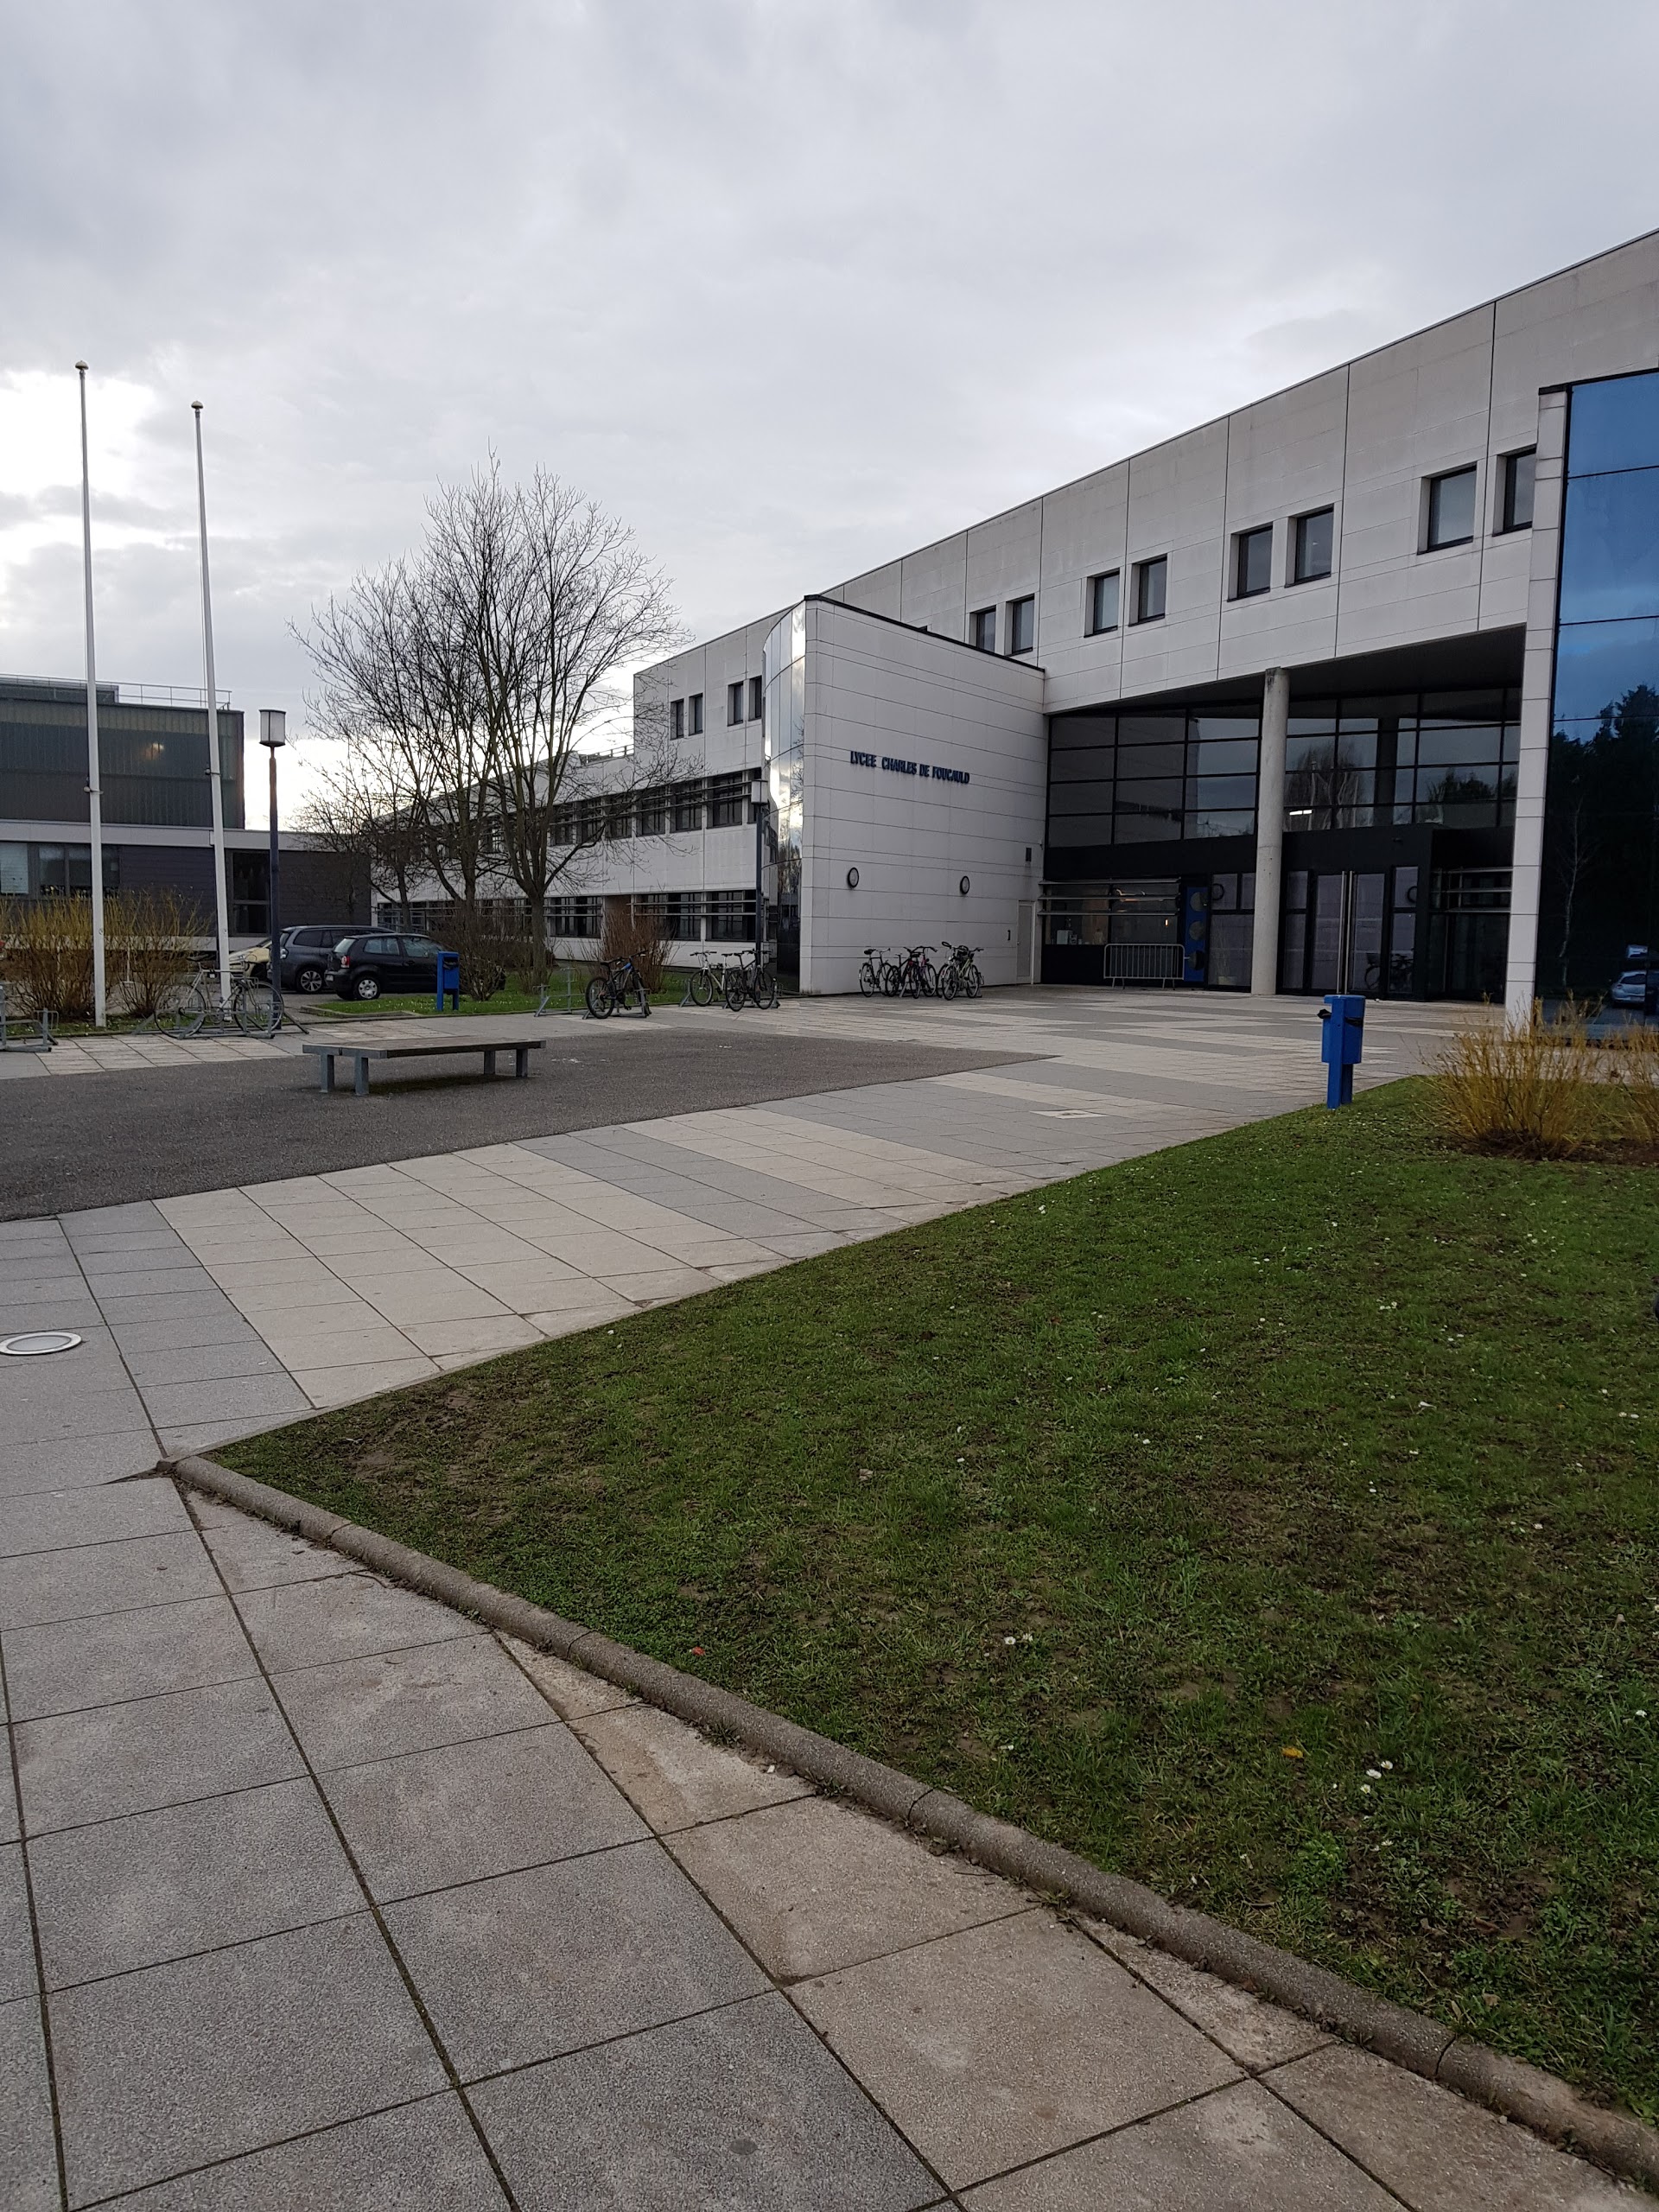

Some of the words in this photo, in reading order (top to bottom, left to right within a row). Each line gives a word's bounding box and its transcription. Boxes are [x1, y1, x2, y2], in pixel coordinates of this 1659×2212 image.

[881, 756, 918, 775] CHARLES
[918, 764, 931, 777] DE
[931, 766, 970, 784] FOUCAULD
